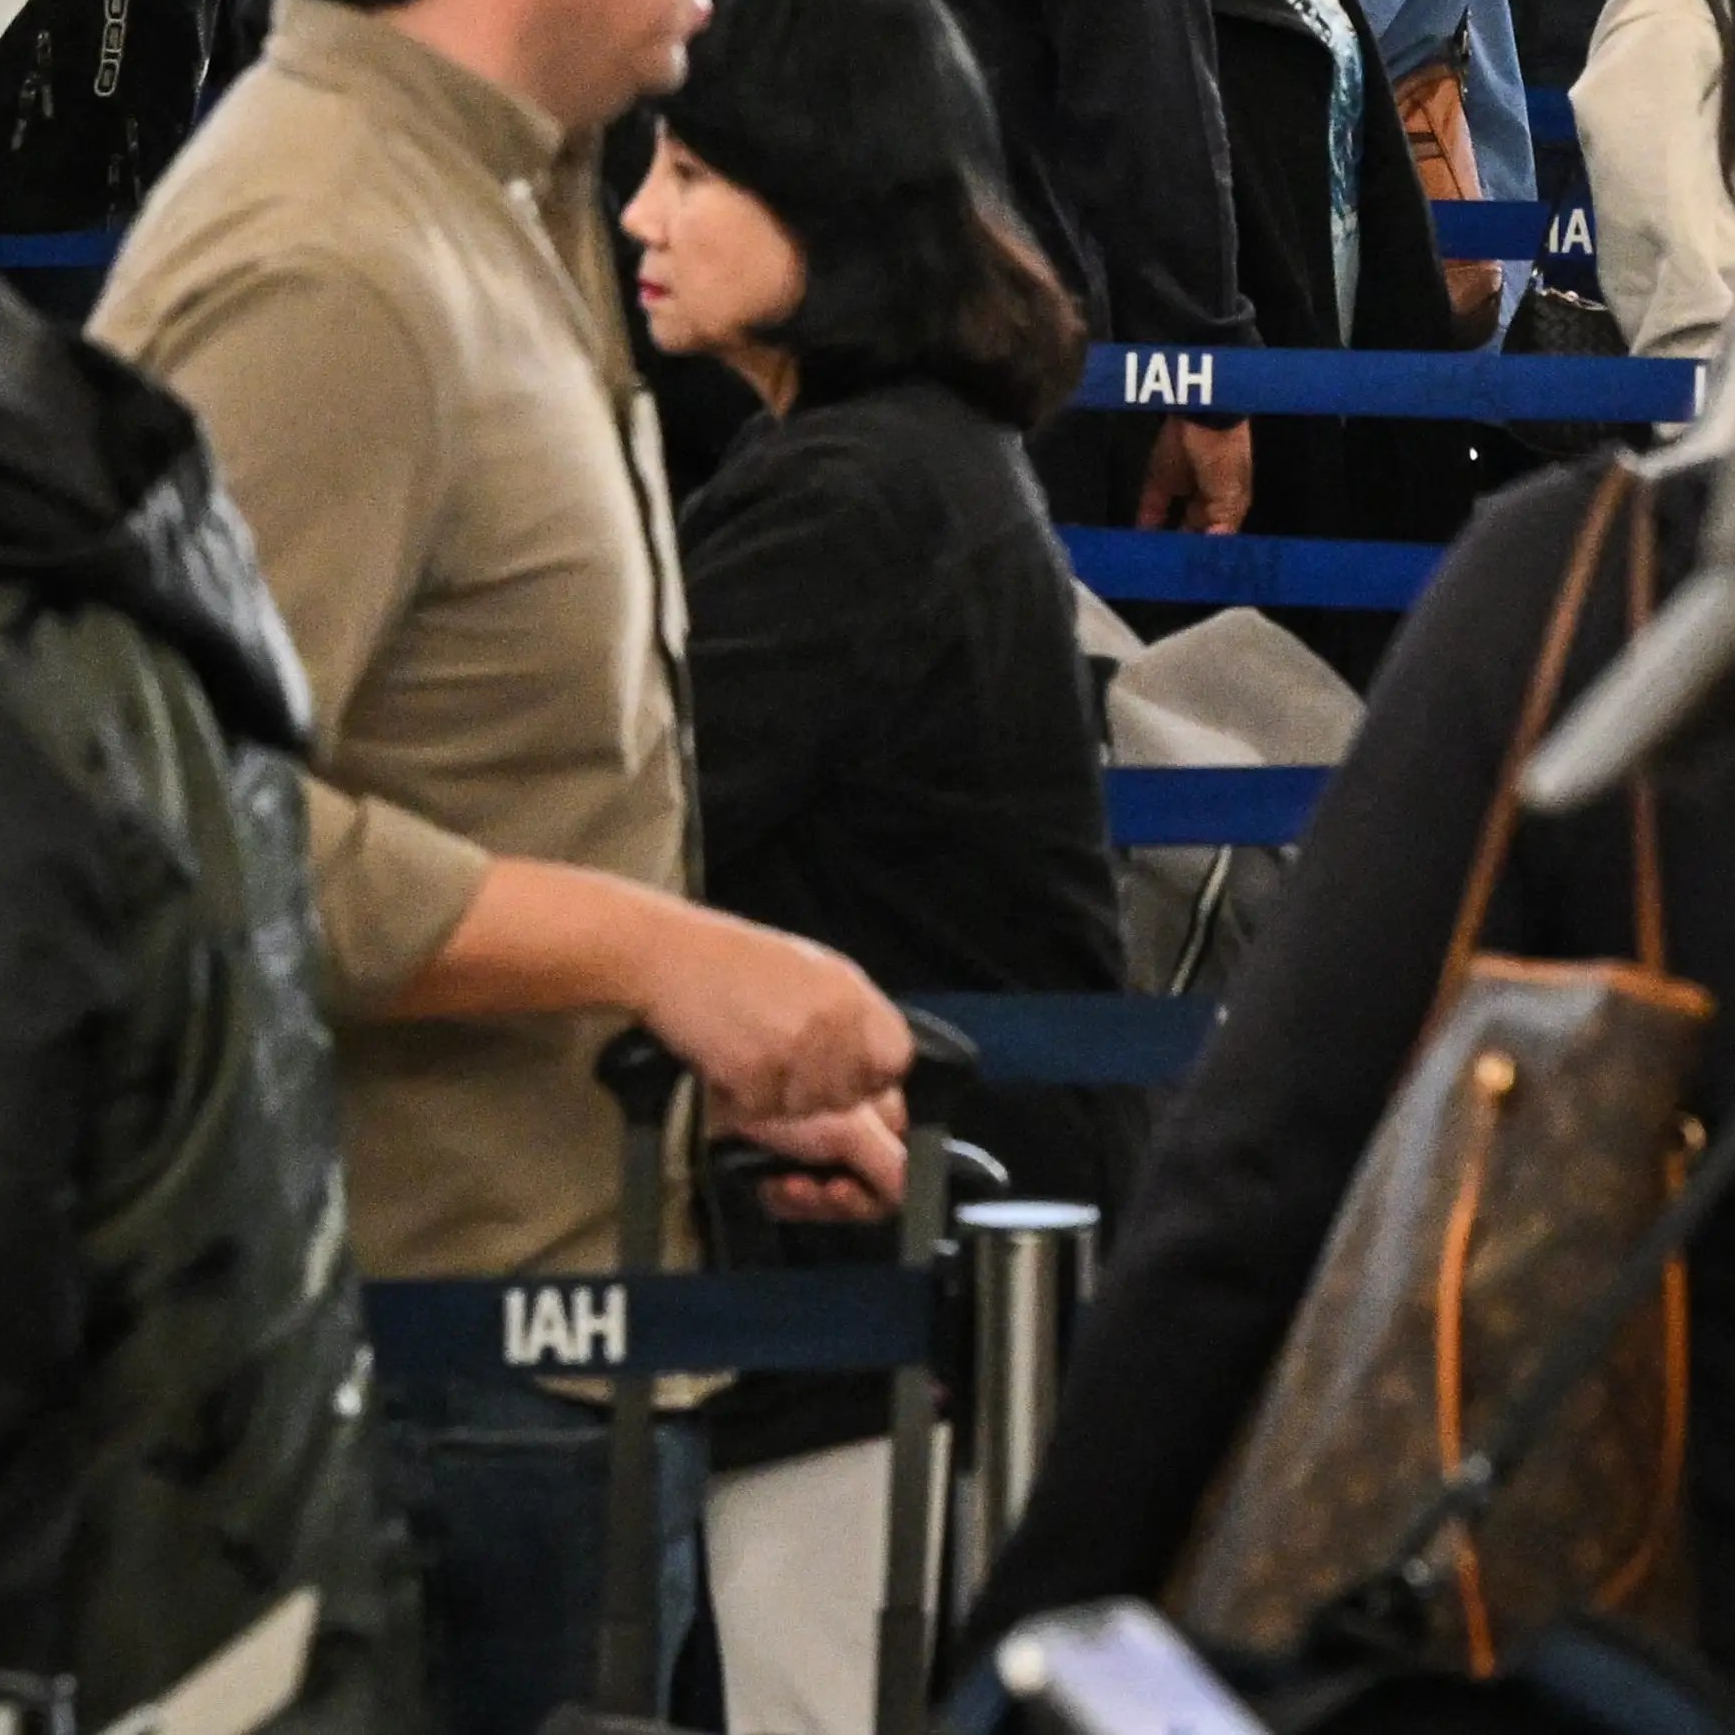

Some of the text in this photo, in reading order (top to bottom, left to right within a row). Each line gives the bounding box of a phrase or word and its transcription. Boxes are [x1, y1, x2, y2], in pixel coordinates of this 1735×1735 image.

[1549, 208, 1594, 255] IA
[1124, 351, 1214, 405] IAH
[504, 1284, 627, 1365] IAH
